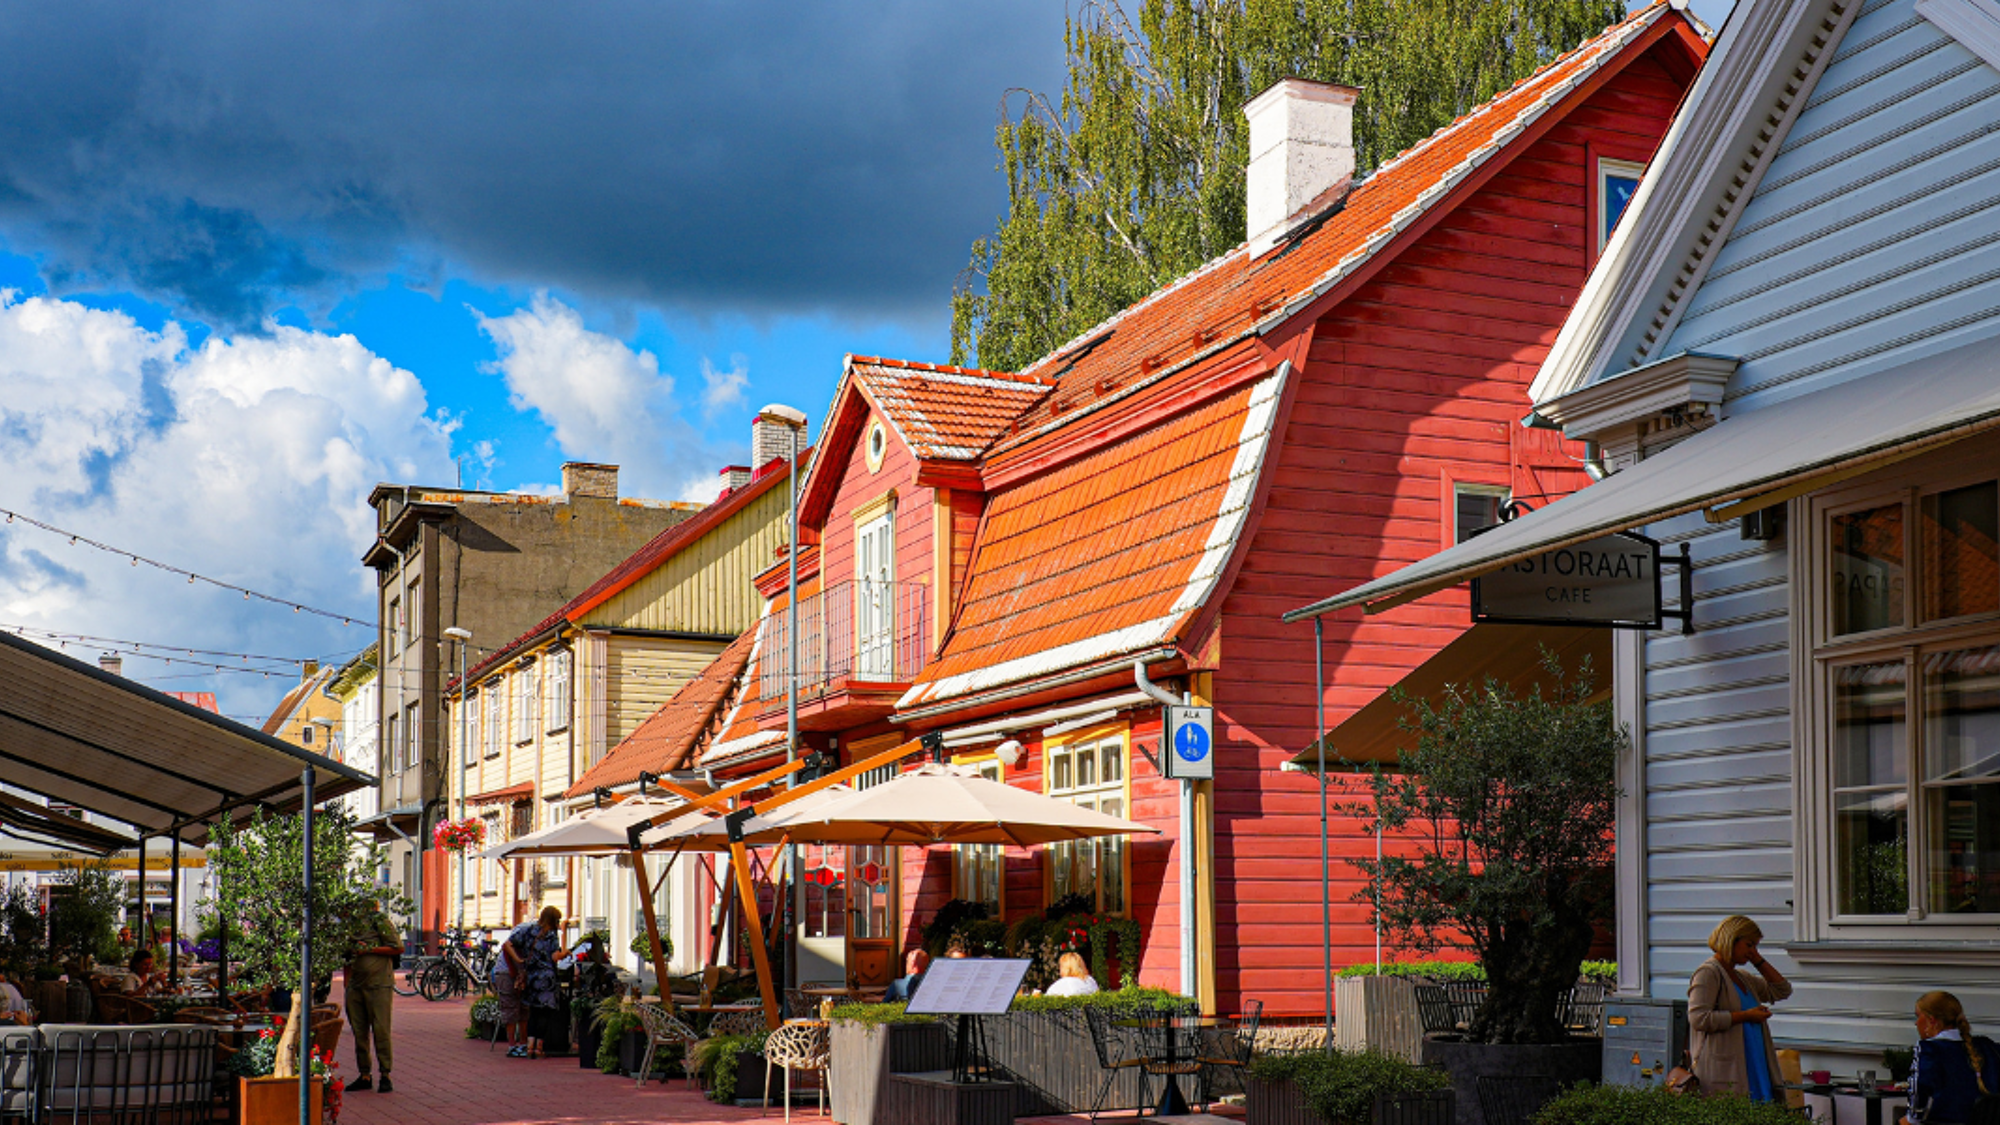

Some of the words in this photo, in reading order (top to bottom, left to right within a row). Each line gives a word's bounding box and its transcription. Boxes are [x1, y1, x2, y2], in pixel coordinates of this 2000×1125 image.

[1501, 550, 1648, 579] STORAAT
[1545, 586, 1591, 603] CAFE
[1183, 710, 1201, 718] ALA
